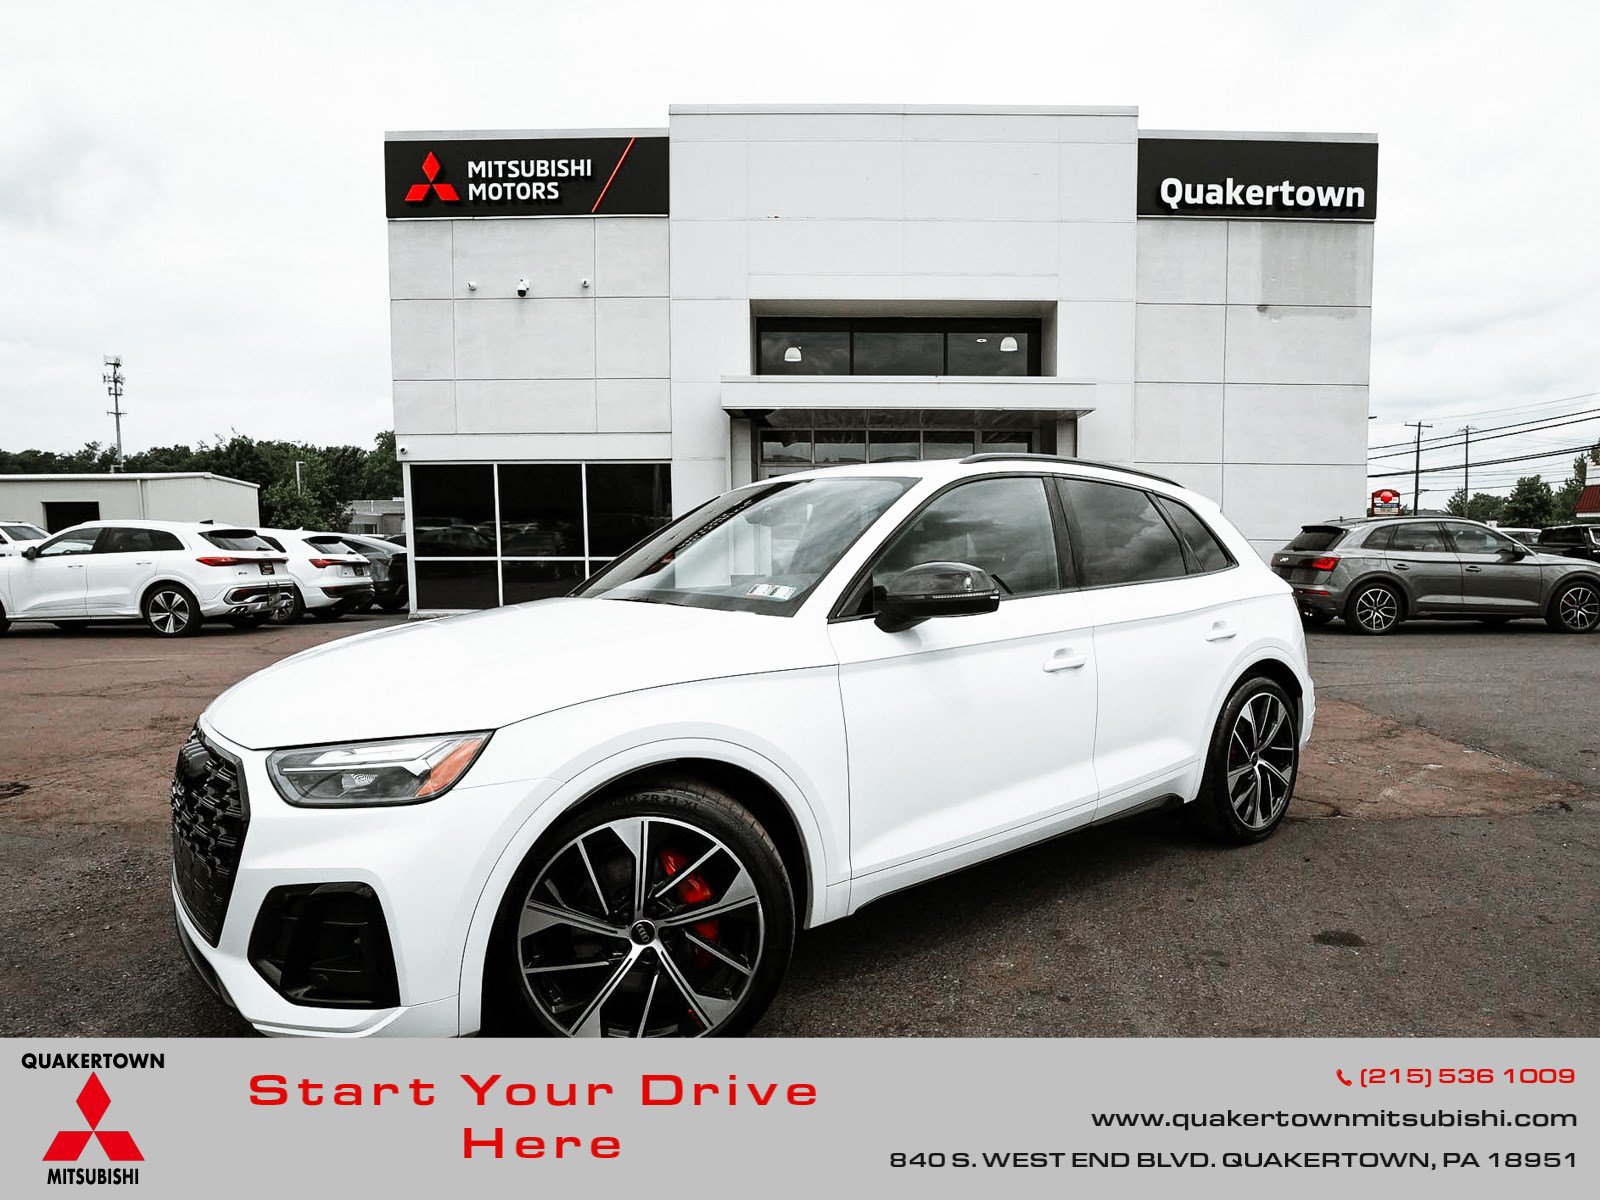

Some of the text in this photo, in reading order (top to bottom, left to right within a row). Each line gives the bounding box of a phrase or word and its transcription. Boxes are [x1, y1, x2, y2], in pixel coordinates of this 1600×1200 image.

[467, 158, 592, 178] MITSUBISHI
[468, 181, 559, 201] MOTORS
[1160, 177, 1365, 210] Quakertown
